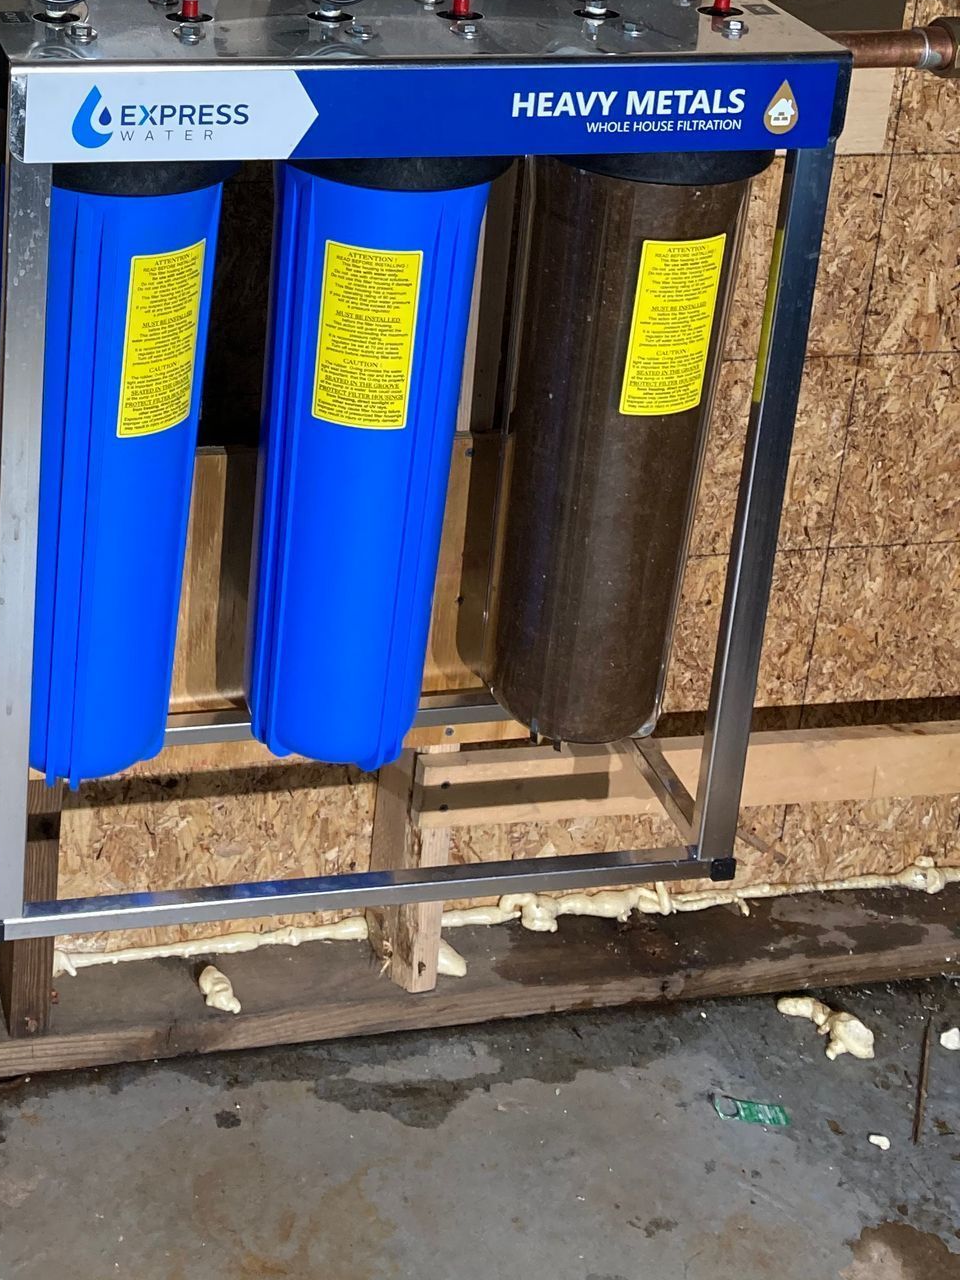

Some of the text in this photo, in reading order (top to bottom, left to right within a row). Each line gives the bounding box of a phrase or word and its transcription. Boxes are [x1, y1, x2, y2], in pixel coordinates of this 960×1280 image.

[511, 88, 746, 118] HEAVY METALS
[119, 103, 249, 126] EXPRESS
[586, 119, 742, 133] WHOLE HOUSE FILTRATION
[119, 129, 214, 142] WATER
[348, 252, 393, 263] ATTENTION
[336, 310, 353, 319] MUST
[365, 315, 401, 323] INSTALLED
[343, 358, 378, 368] CAUTION
